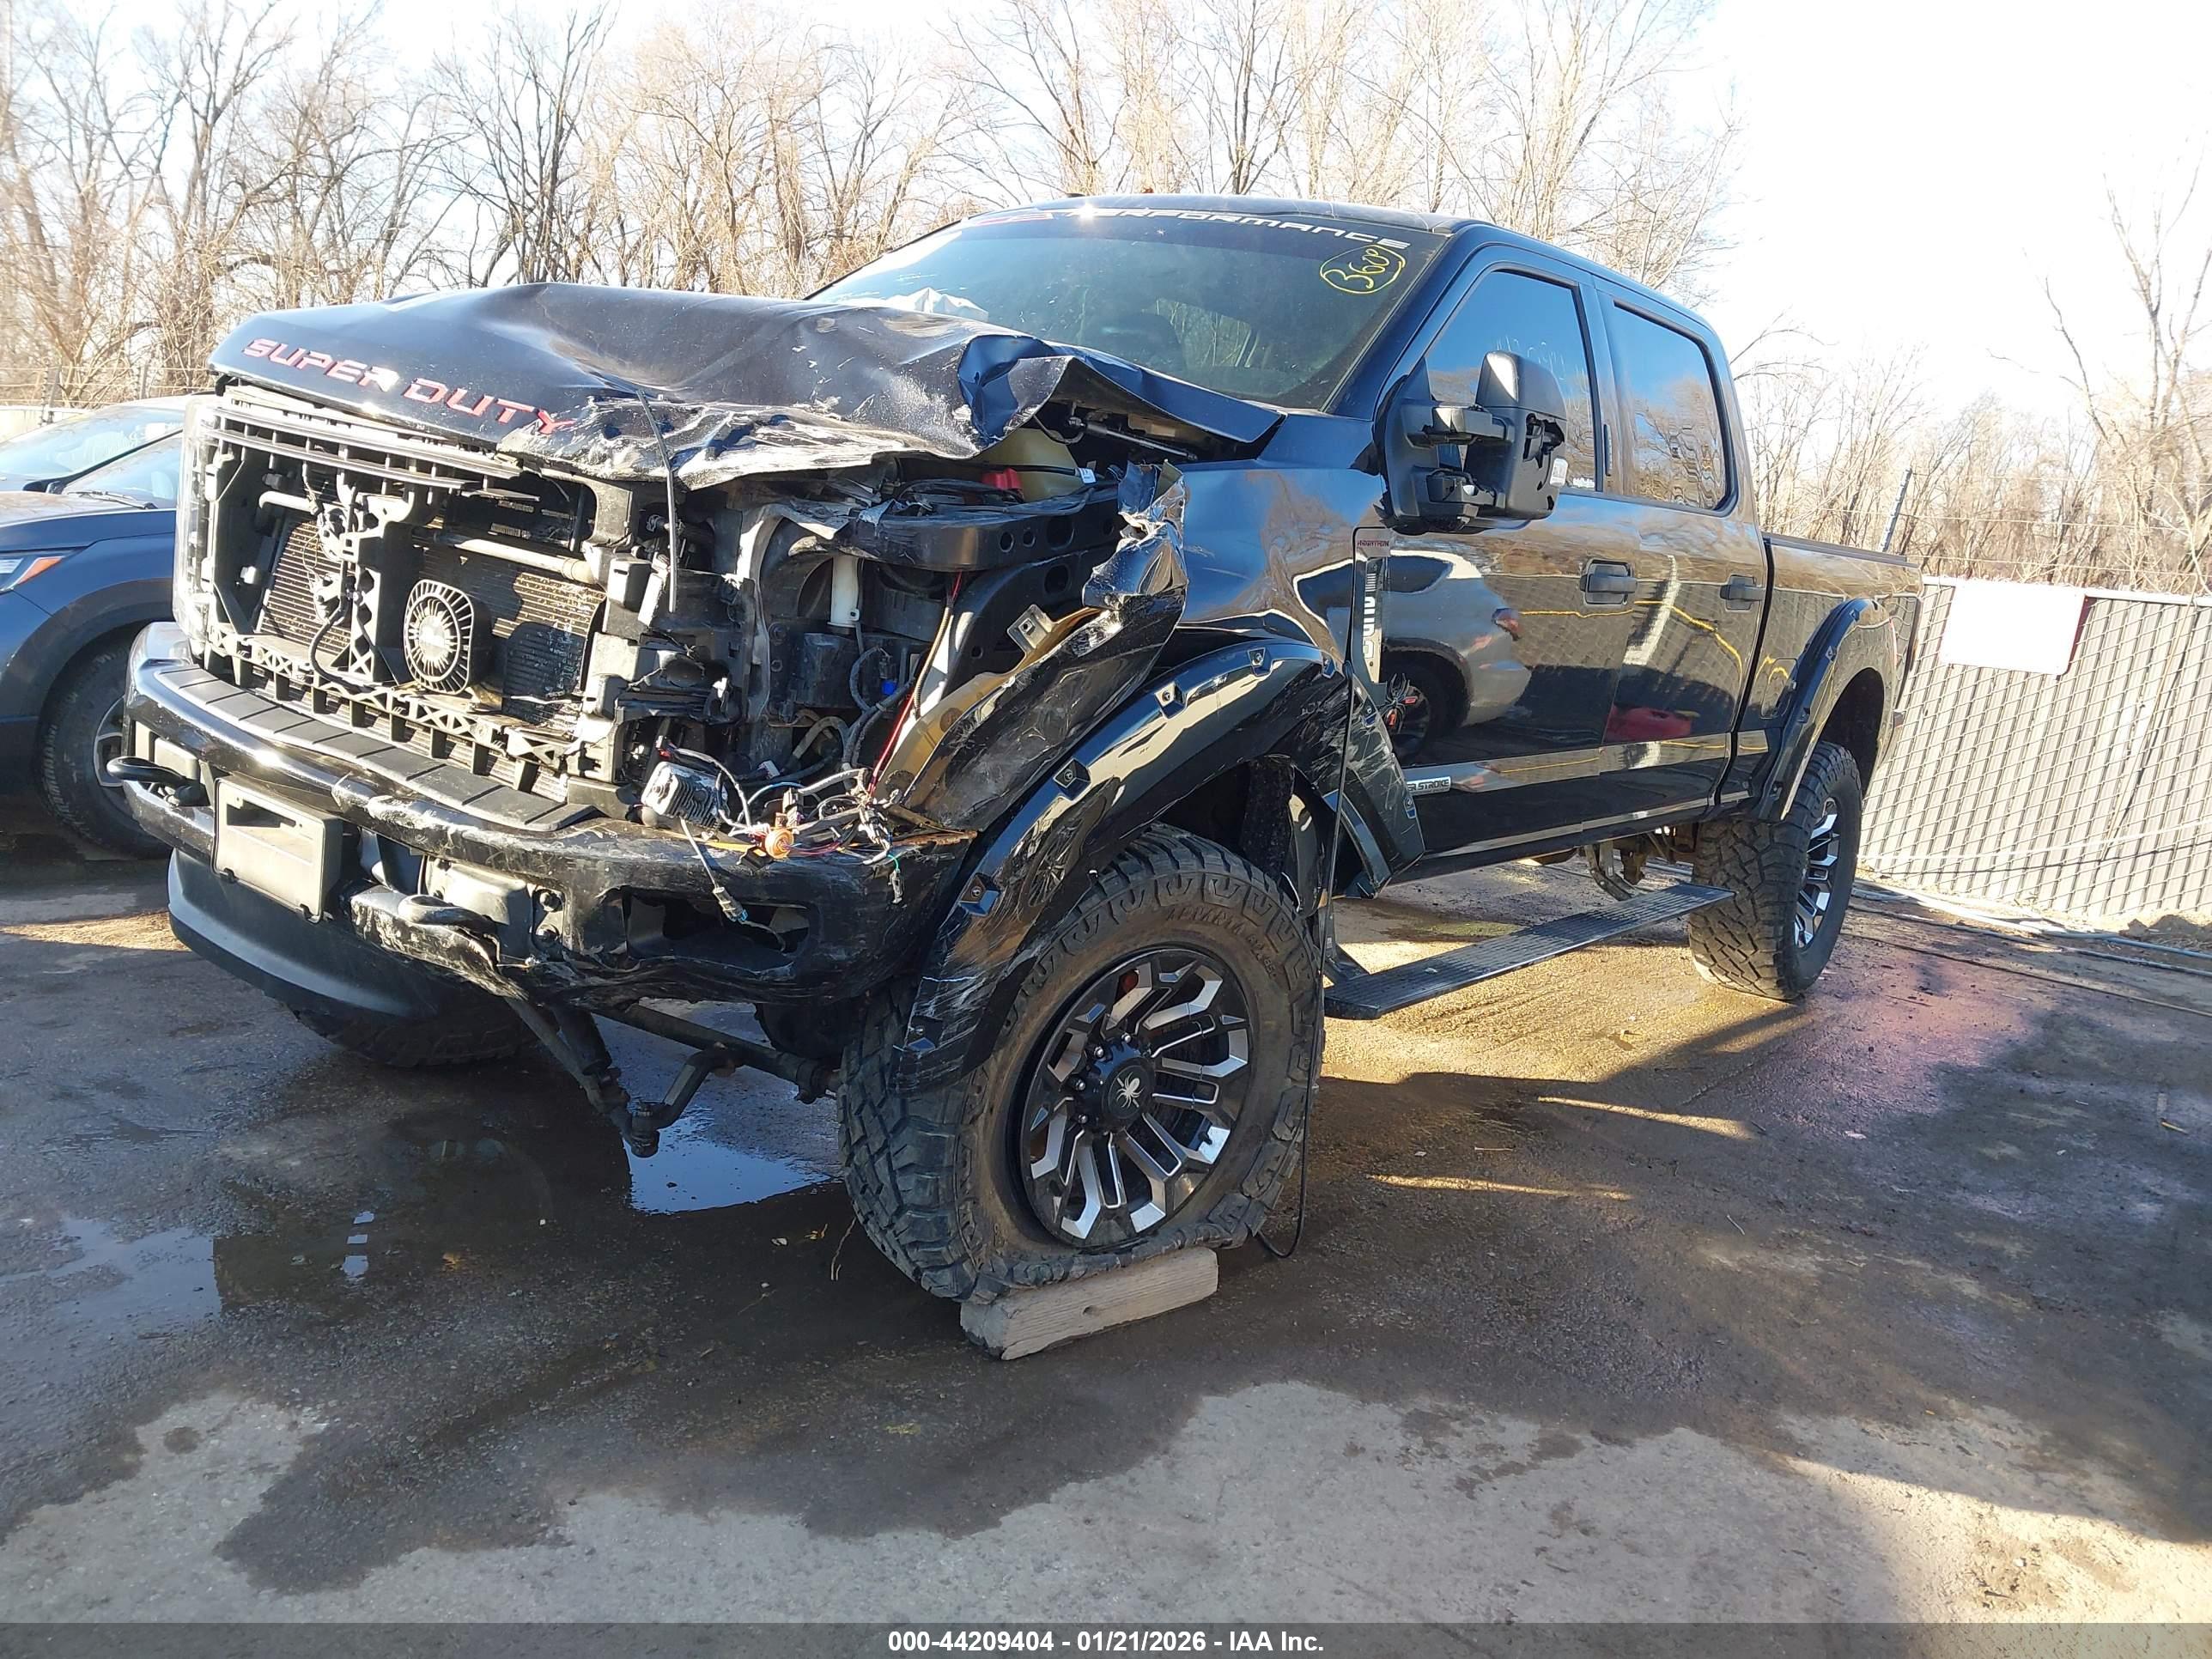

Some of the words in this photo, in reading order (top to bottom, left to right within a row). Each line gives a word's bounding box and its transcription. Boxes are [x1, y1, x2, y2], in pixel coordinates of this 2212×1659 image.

[1066, 207, 1411, 250] ERFORMANCE
[242, 337, 401, 393] SUPER
[403, 377, 577, 435] DUTY
[1418, 779, 1450, 791] STROKE
